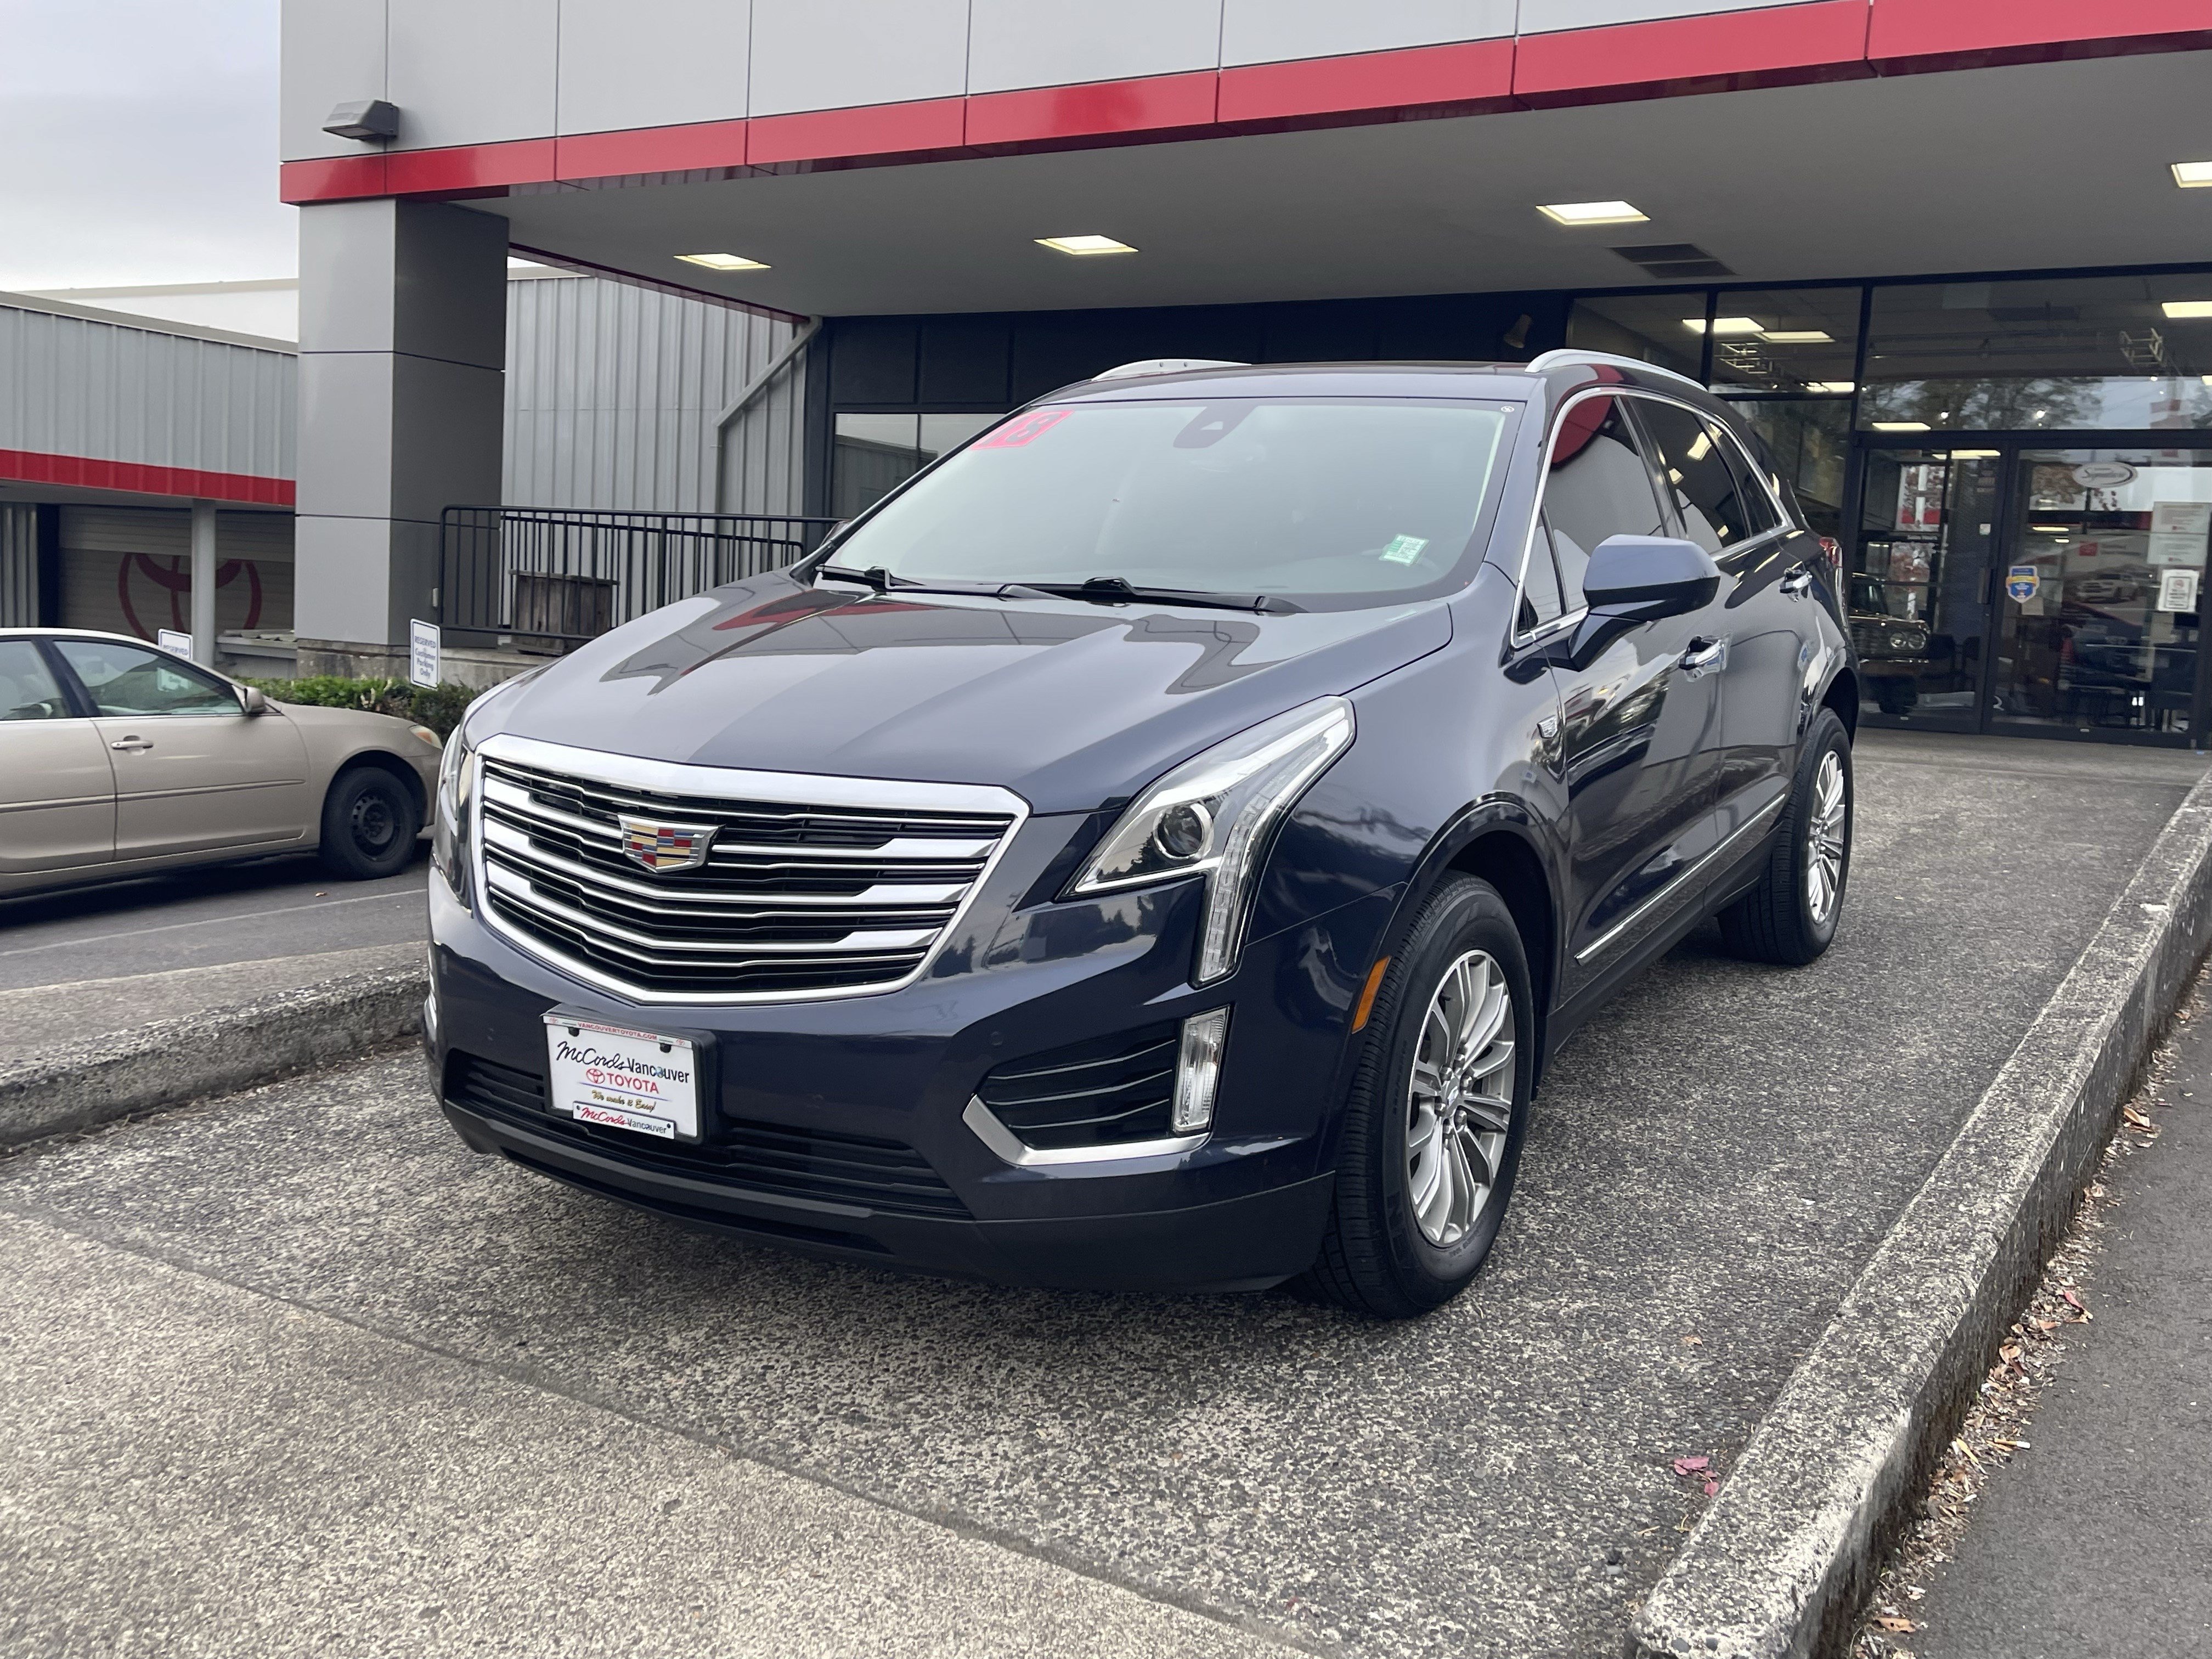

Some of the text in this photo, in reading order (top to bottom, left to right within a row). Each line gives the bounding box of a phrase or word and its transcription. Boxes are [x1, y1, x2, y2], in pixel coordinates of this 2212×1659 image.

[975, 412, 1063, 447] 18
[415, 636, 437, 648] RESERVED
[415, 647, 436, 660] Customer
[417, 657, 434, 672] Parking
[577, 1022, 658, 1040] VANCOUVERTOYOTA.COM
[607, 1073, 659, 1094] TOYOTA
